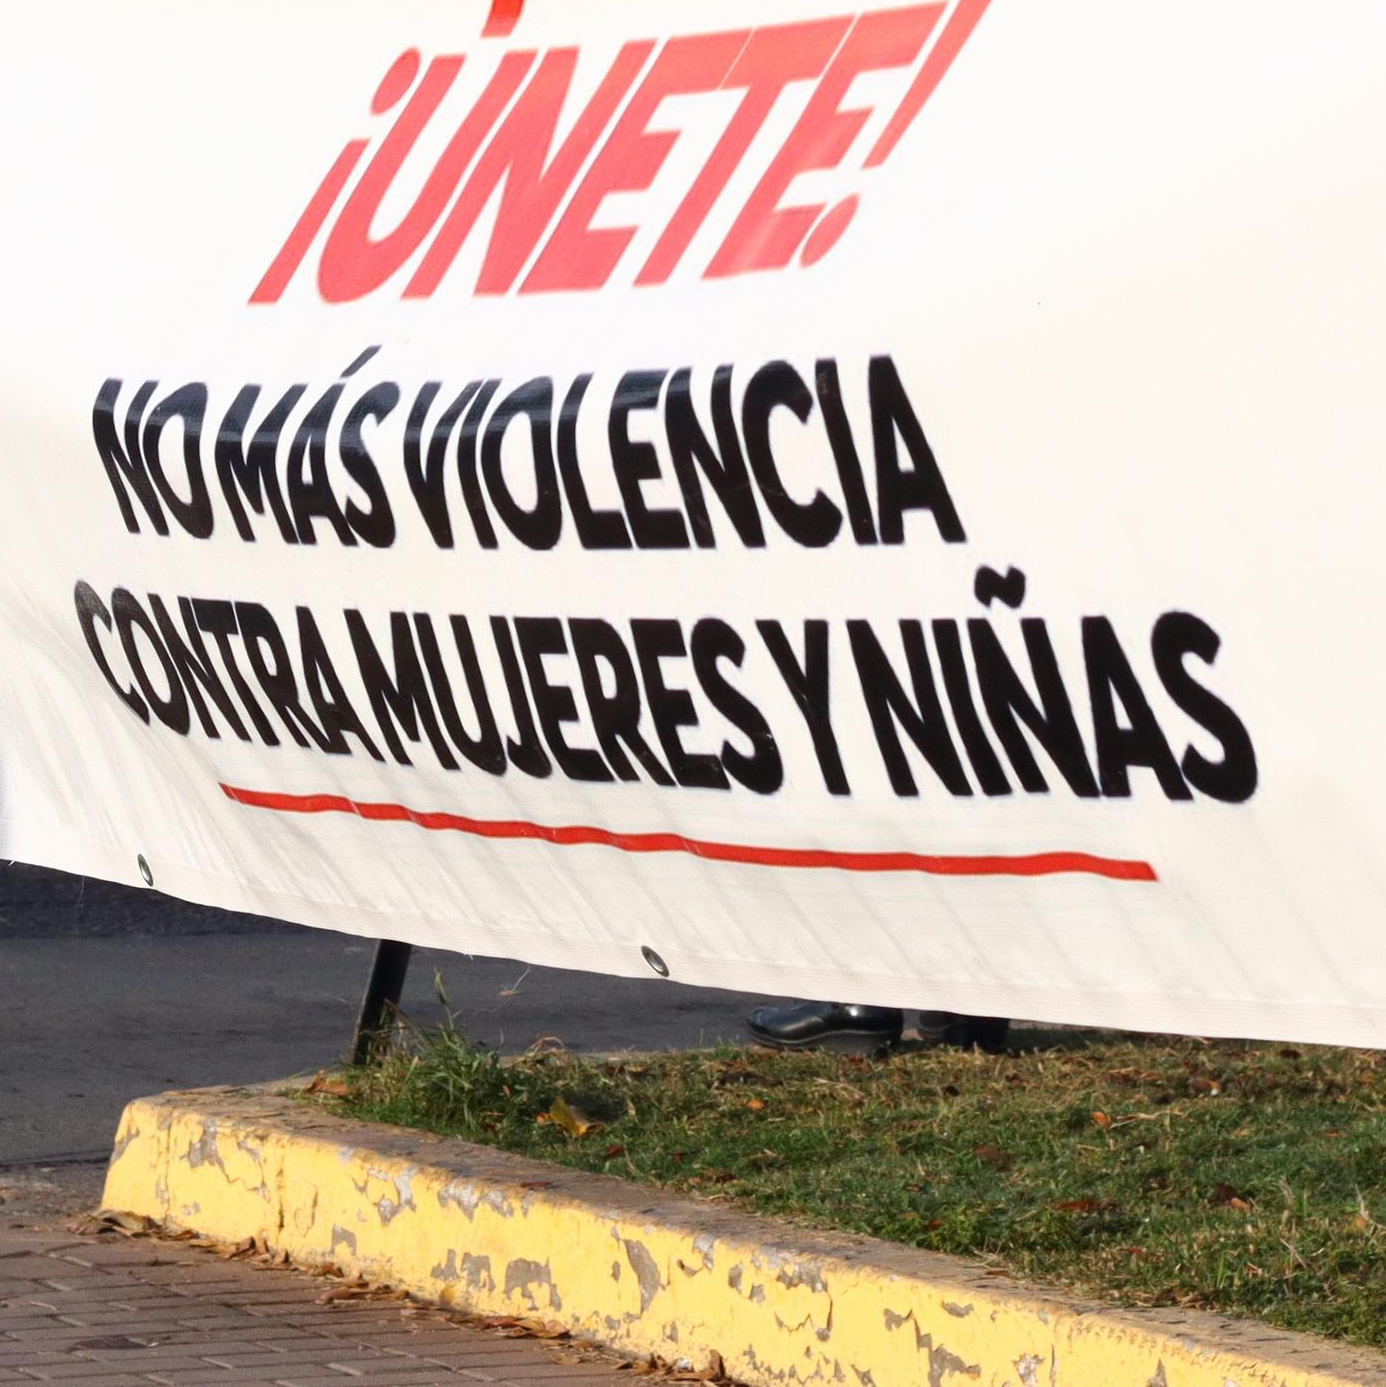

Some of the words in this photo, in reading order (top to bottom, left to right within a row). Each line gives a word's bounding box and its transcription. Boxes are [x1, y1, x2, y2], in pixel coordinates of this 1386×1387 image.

[92, 378, 215, 541] NO
[214, 346, 401, 550] MÁS
[403, 354, 968, 551] VIOLENCIA
[74, 580, 385, 764] CONTRA
[344, 608, 784, 797] MUJERES
[756, 618, 851, 796] Y
[847, 565, 1258, 804] NIÑAS
